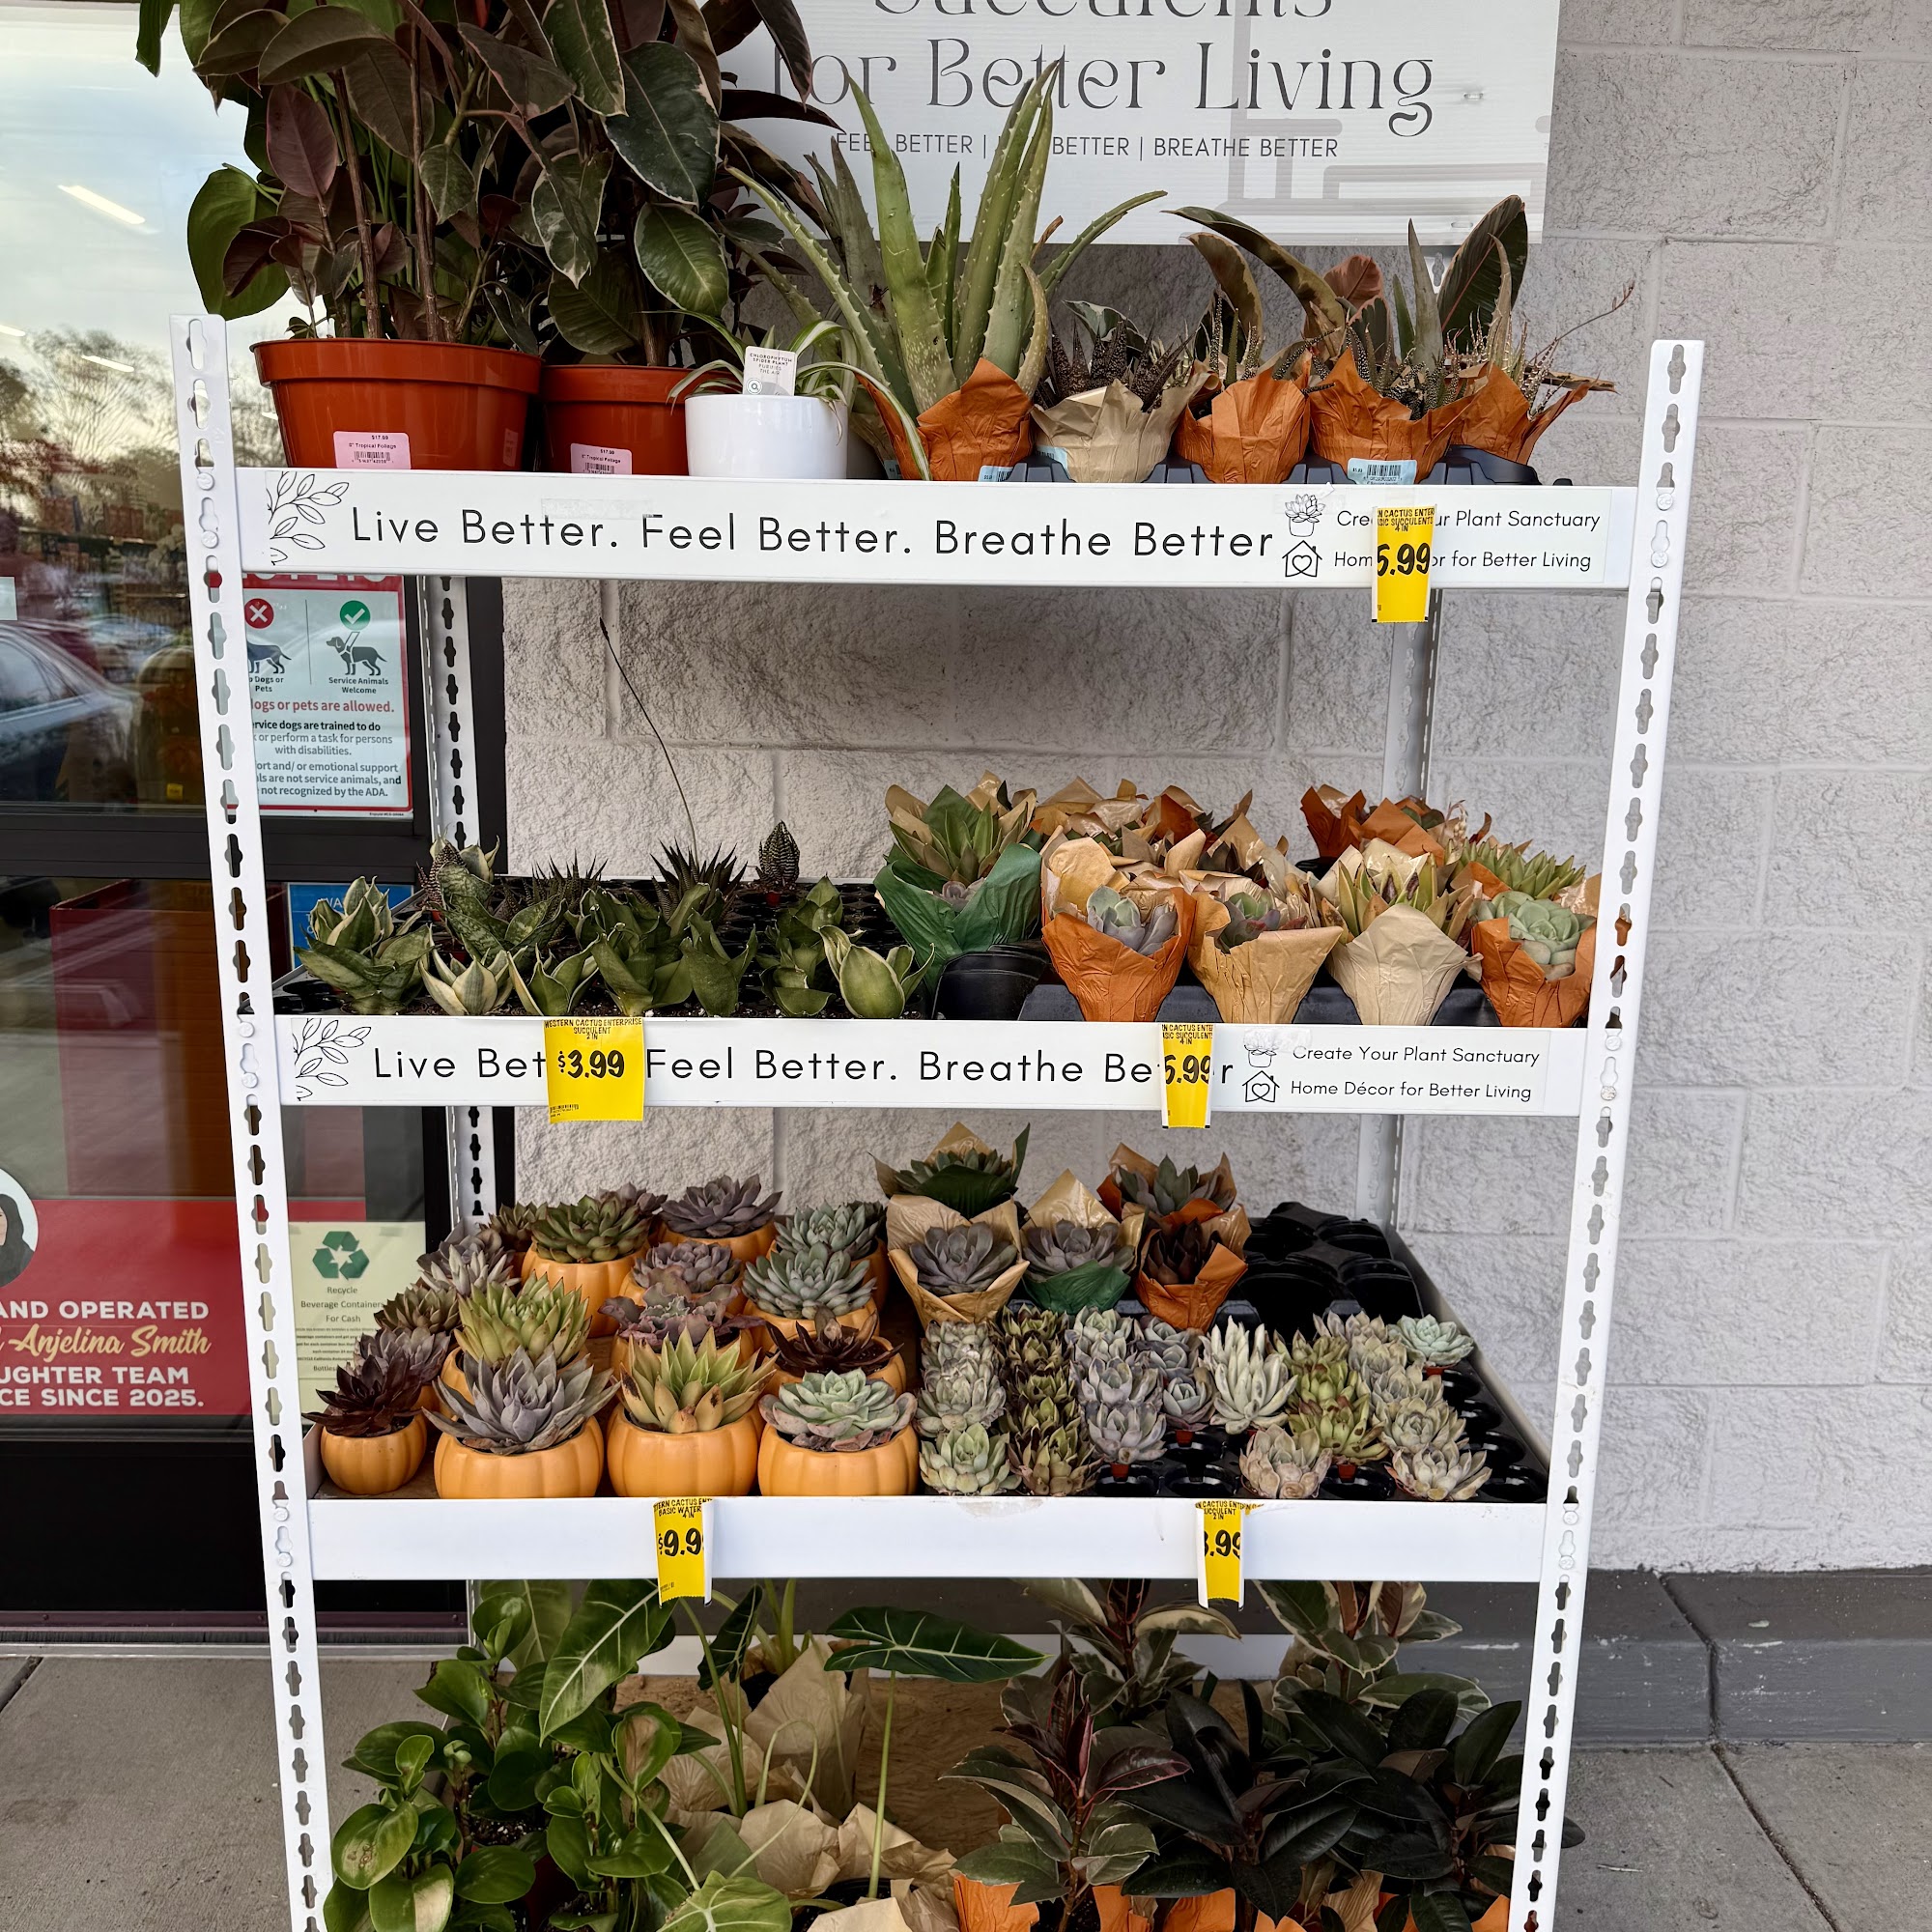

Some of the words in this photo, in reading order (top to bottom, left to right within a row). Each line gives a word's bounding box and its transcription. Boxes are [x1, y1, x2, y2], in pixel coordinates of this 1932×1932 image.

[927, 38, 1166, 109] Better
[1194, 42, 1434, 137] Living
[837, 132, 871, 152] FEE
[896, 133, 973, 154] BETTER
[1053, 136, 1129, 156] BETTER
[1154, 137, 1249, 156] BREATHE
[1260, 137, 1338, 157] BETTER
[1414, 507, 1435, 517] ENTER
[1337, 509, 1373, 526] Cre
[1456, 510, 1501, 527] Plant
[1508, 510, 1601, 531] Sanctuary
[354, 506, 439, 544] Live
[462, 508, 617, 549] Better.
[642, 512, 734, 550] Feel
[759, 516, 911, 554] Better.
[936, 518, 1111, 555] Breathe
[1134, 522, 1273, 556] Better
[1334, 552, 1373, 567] Hom
[1452, 552, 1477, 567] for
[1483, 552, 1540, 567] Better
[1543, 552, 1591, 572] Living
[255, 676, 274, 685] Dogs
[342, 686, 377, 695] Welcome
[277, 701, 291, 710] or
[293, 700, 319, 713] pets
[321, 702, 341, 711] are
[343, 700, 395, 713] allowed.
[253, 720, 278, 729] rvice
[279, 720, 302, 731] dogs
[321, 721, 355, 731] trained
[355, 723, 367, 731] to
[368, 722, 382, 731] do
[258, 733, 270, 742] or
[270, 732, 309, 744] perform
[318, 733, 339, 743] task
[340, 733, 355, 743] for
[355, 735, 393, 745] persons
[274, 745, 297, 754] with
[298, 745, 353, 755] disabilities.
[308, 762, 359, 772] emotional
[359, 764, 399, 774] support
[286, 775, 303, 783] not
[304, 775, 339, 784] service
[340, 775, 382, 786] animals,
[383, 776, 402, 784] and
[261, 786, 278, 795] not
[279, 786, 332, 798] recognized
[334, 786, 346, 798] by
[347, 787, 364, 796] the
[365, 787, 388, 797] ADA.
[544, 1019, 574, 1029] WESTERN
[603, 1017, 642, 1027] ENTERPRISE
[573, 1026, 611, 1035] SUCCULENT
[1293, 1045, 1352, 1060] Create
[1359, 1045, 1399, 1061] Your
[1404, 1046, 1447, 1062] Plant
[1452, 1047, 1540, 1067] Sanctuary
[375, 1047, 455, 1078] Live
[478, 1048, 546, 1078] Bet
[646, 1046, 732, 1079] Feel
[755, 1049, 896, 1080] Better.
[920, 1049, 1084, 1082] Breathe
[557, 1049, 625, 1078] $3.99
[1291, 1081, 1339, 1095] Home
[1345, 1081, 1395, 1096] Décor
[1400, 1081, 1424, 1096] for
[1429, 1083, 1481, 1097] Better
[1486, 1084, 1532, 1102] Living
[327, 1286, 358, 1295] Recycle
[59, 1301, 210, 1320] OPERATED
[300, 1300, 339, 1309] Beverage
[9, 1322, 125, 1363] Anjelina
[130, 1324, 212, 1357] Smith
[0, 1366, 102, 1384] UGHTER
[112, 1367, 189, 1384] TEAM
[41, 1388, 120, 1406] SINCE
[129, 1388, 205, 1407] 2025.
[671, 1498, 697, 1507] CACTUS
[659, 1507, 676, 1517] BASIC
[658, 1527, 703, 1557] $9.9
